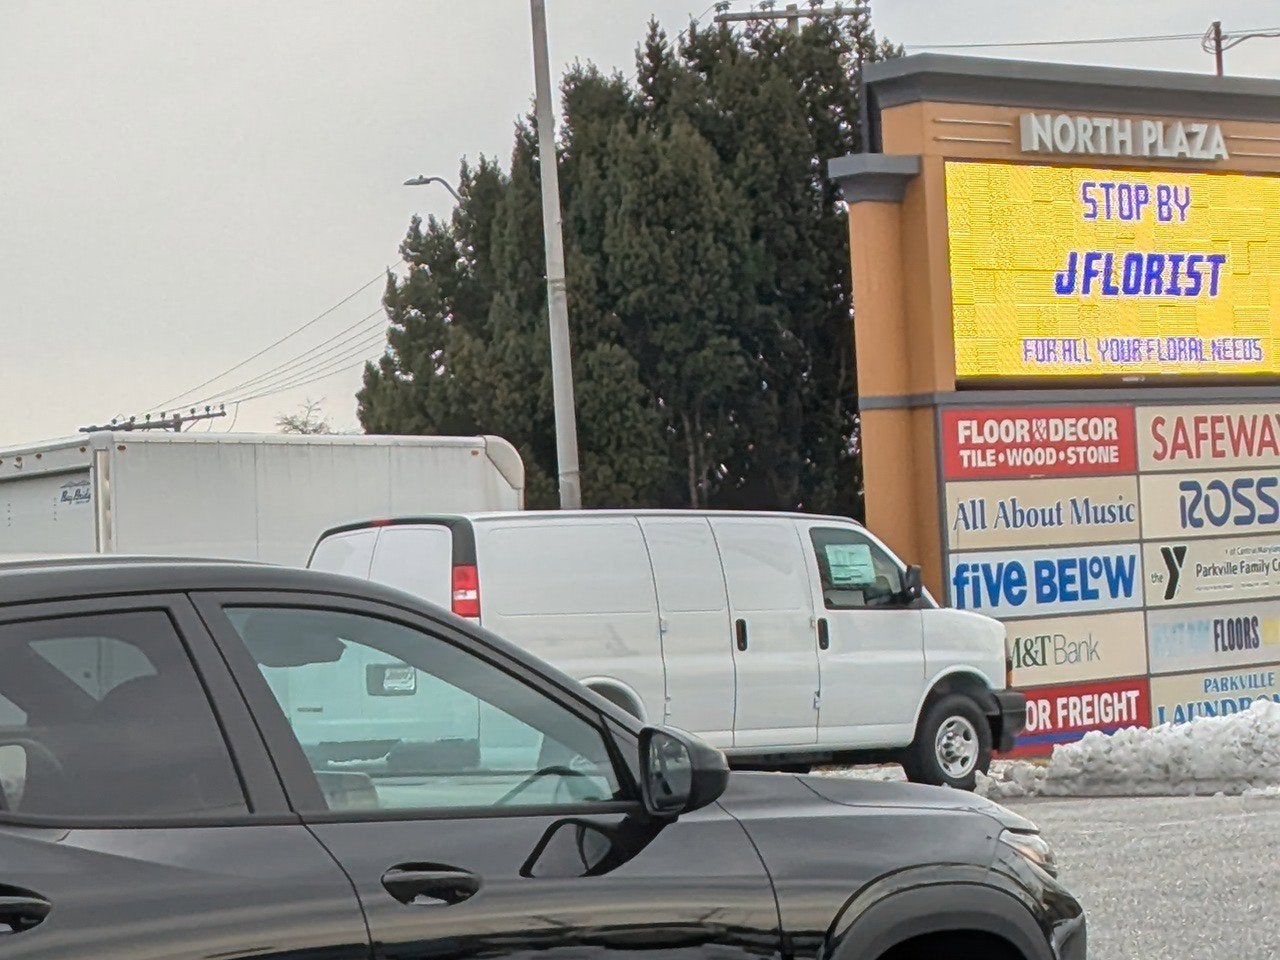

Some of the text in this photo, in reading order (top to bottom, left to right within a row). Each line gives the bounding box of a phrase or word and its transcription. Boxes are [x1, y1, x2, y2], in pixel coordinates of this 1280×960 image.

[1022, 113, 1230, 160] NORTH PLAZA
[1082, 181, 1190, 222] STOP BY
[1023, 337, 1263, 362] FOR ALL YOUR FLORAL NEEDS
[957, 417, 1119, 445] FLOOR & DECOR
[953, 494, 1136, 531] All About Music
[1179, 477, 1280, 529] ROSS
[1240, 557, 1271, 576] Family
[1053, 632, 1101, 665] Bank
[1213, 616, 1260, 652] FLOORS
[1204, 672, 1275, 693] PARKVILLE
[1056, 690, 1140, 728] FREIGHT
